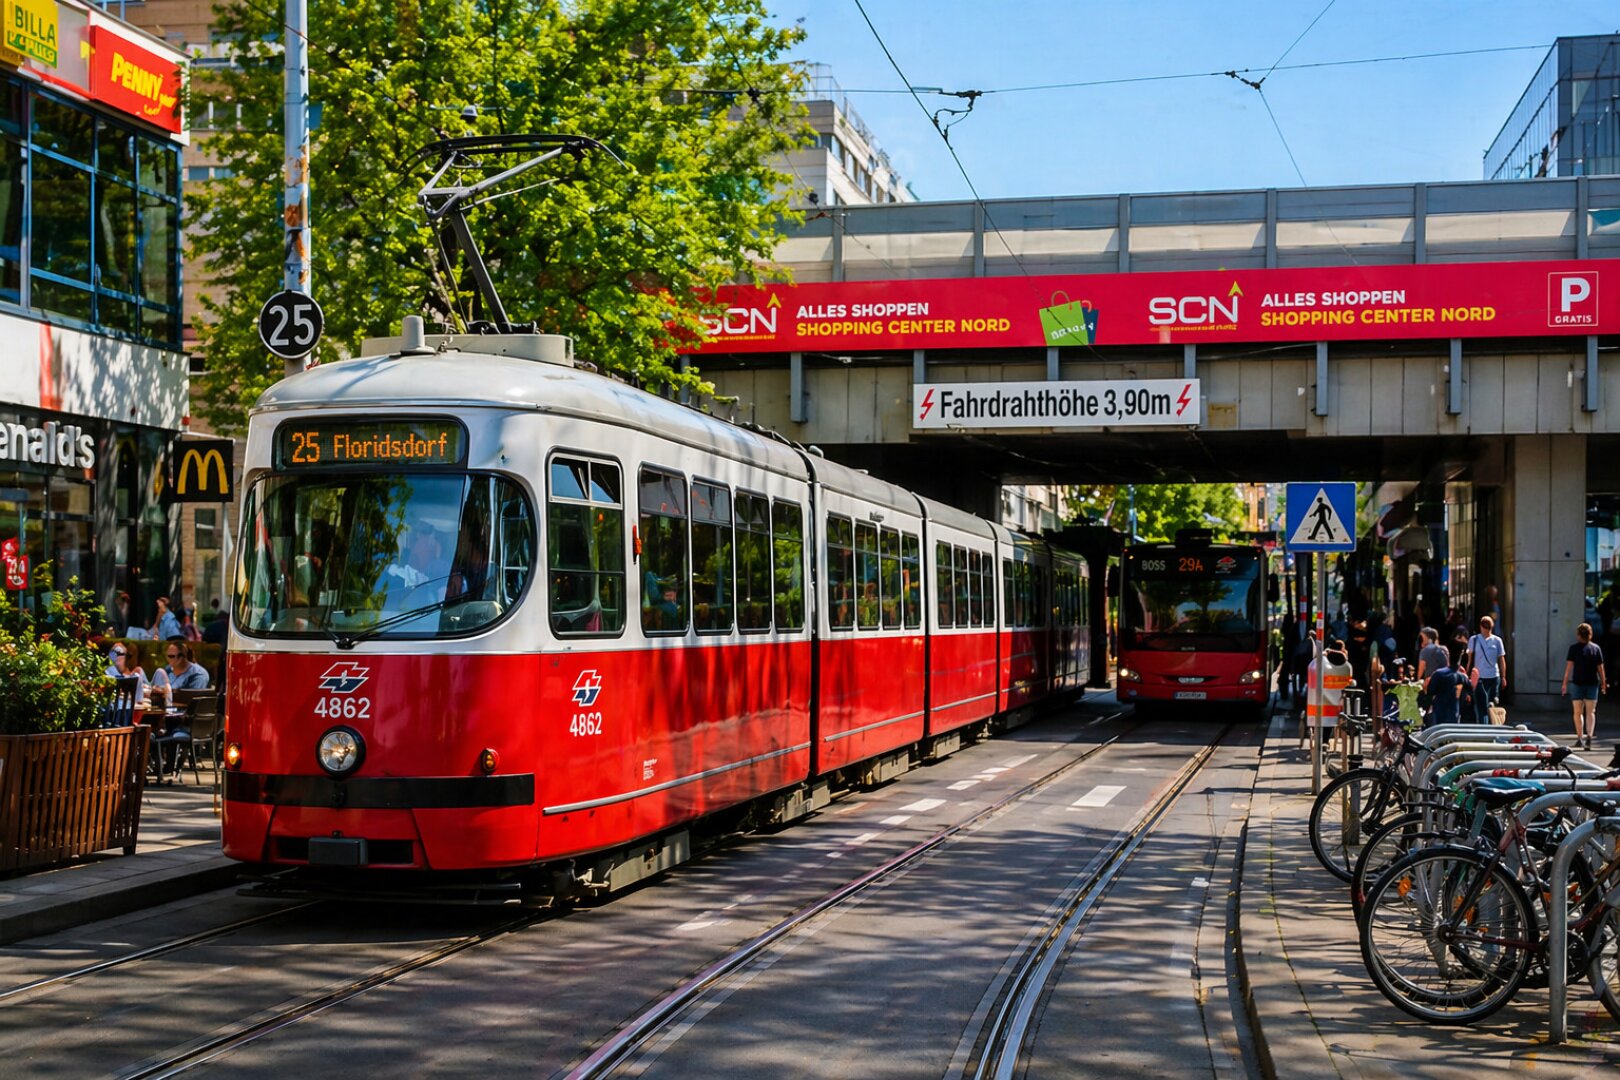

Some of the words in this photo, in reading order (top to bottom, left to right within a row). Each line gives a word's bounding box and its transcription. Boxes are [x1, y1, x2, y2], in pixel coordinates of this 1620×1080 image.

[15, 4, 56, 47] BILLA
[111, 51, 164, 101] PENNY
[1261, 292, 1316, 307] ALLES
[1320, 289, 1406, 306] SHOPPEN
[1561, 277, 1590, 312] P
[699, 307, 777, 335] SCN
[796, 305, 847, 319] ALLES
[851, 302, 929, 317] SHOPPEN
[1148, 295, 1239, 325] SCN
[1260, 309, 1357, 327] SHOPPING
[1360, 308, 1437, 325] CENTER
[1441, 306, 1496, 322] NORD
[1554, 314, 1593, 324] GRATIS
[268, 304, 315, 346] 25
[796, 320, 883, 336] SHOPPING
[888, 320, 955, 334] CENTER
[961, 318, 1011, 332] NORD
[940, 389, 1099, 418] Fahrdrahthöhe
[1103, 388, 1171, 419] 3,90m
[291, 431, 321, 463] 25
[333, 432, 448, 459] Floridsdorf
[1178, 557, 1204, 572] 29A
[313, 697, 371, 719] 4862
[569, 712, 602, 737] 4862
